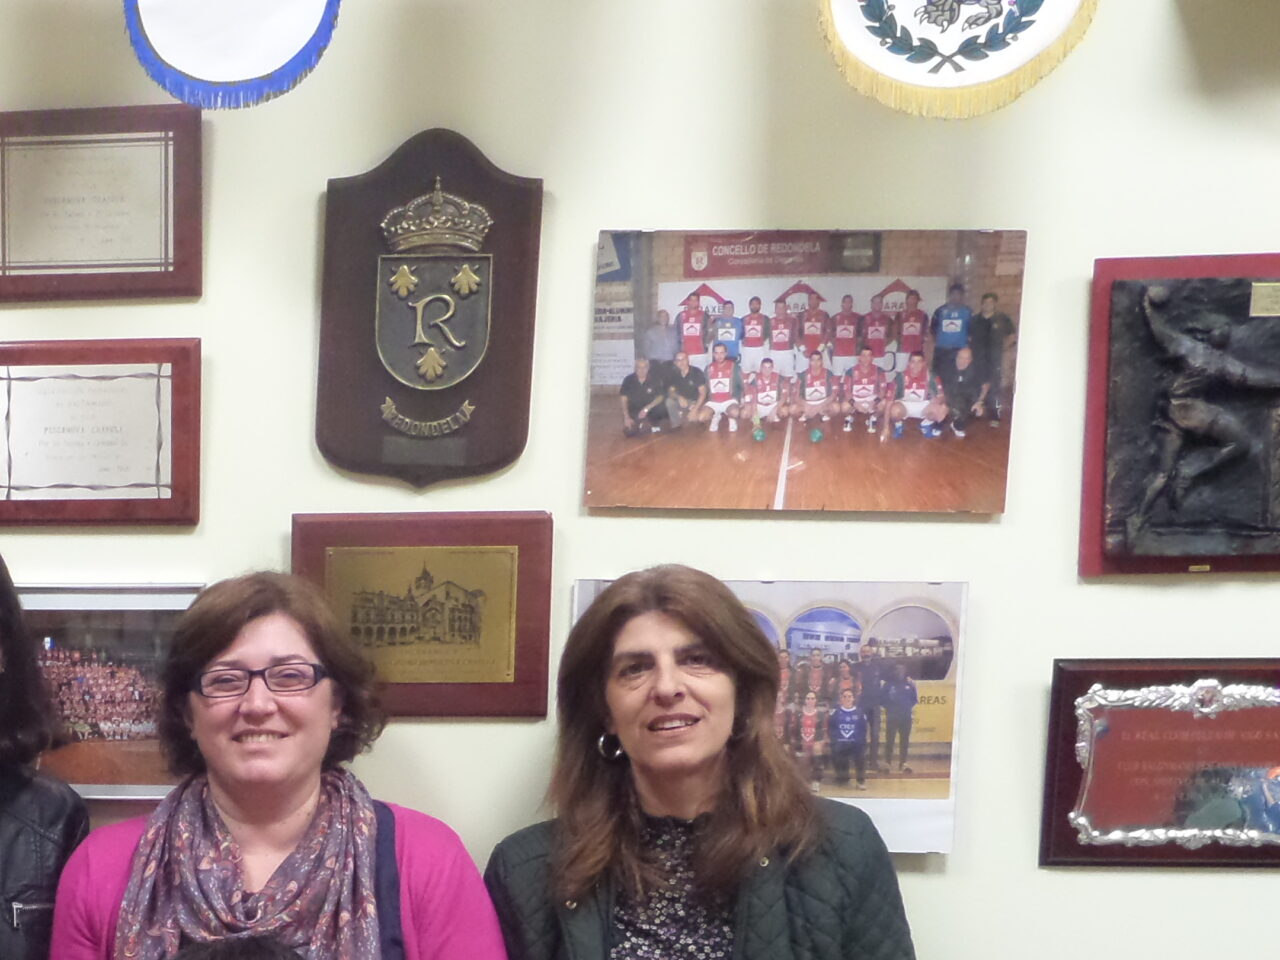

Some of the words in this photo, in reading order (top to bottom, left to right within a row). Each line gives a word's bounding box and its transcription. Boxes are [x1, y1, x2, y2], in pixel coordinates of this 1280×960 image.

[712, 244, 756, 256] CONCELLO
[757, 243, 768, 254] DE
[408, 294, 466, 348] R
[919, 696, 947, 705] REAS
